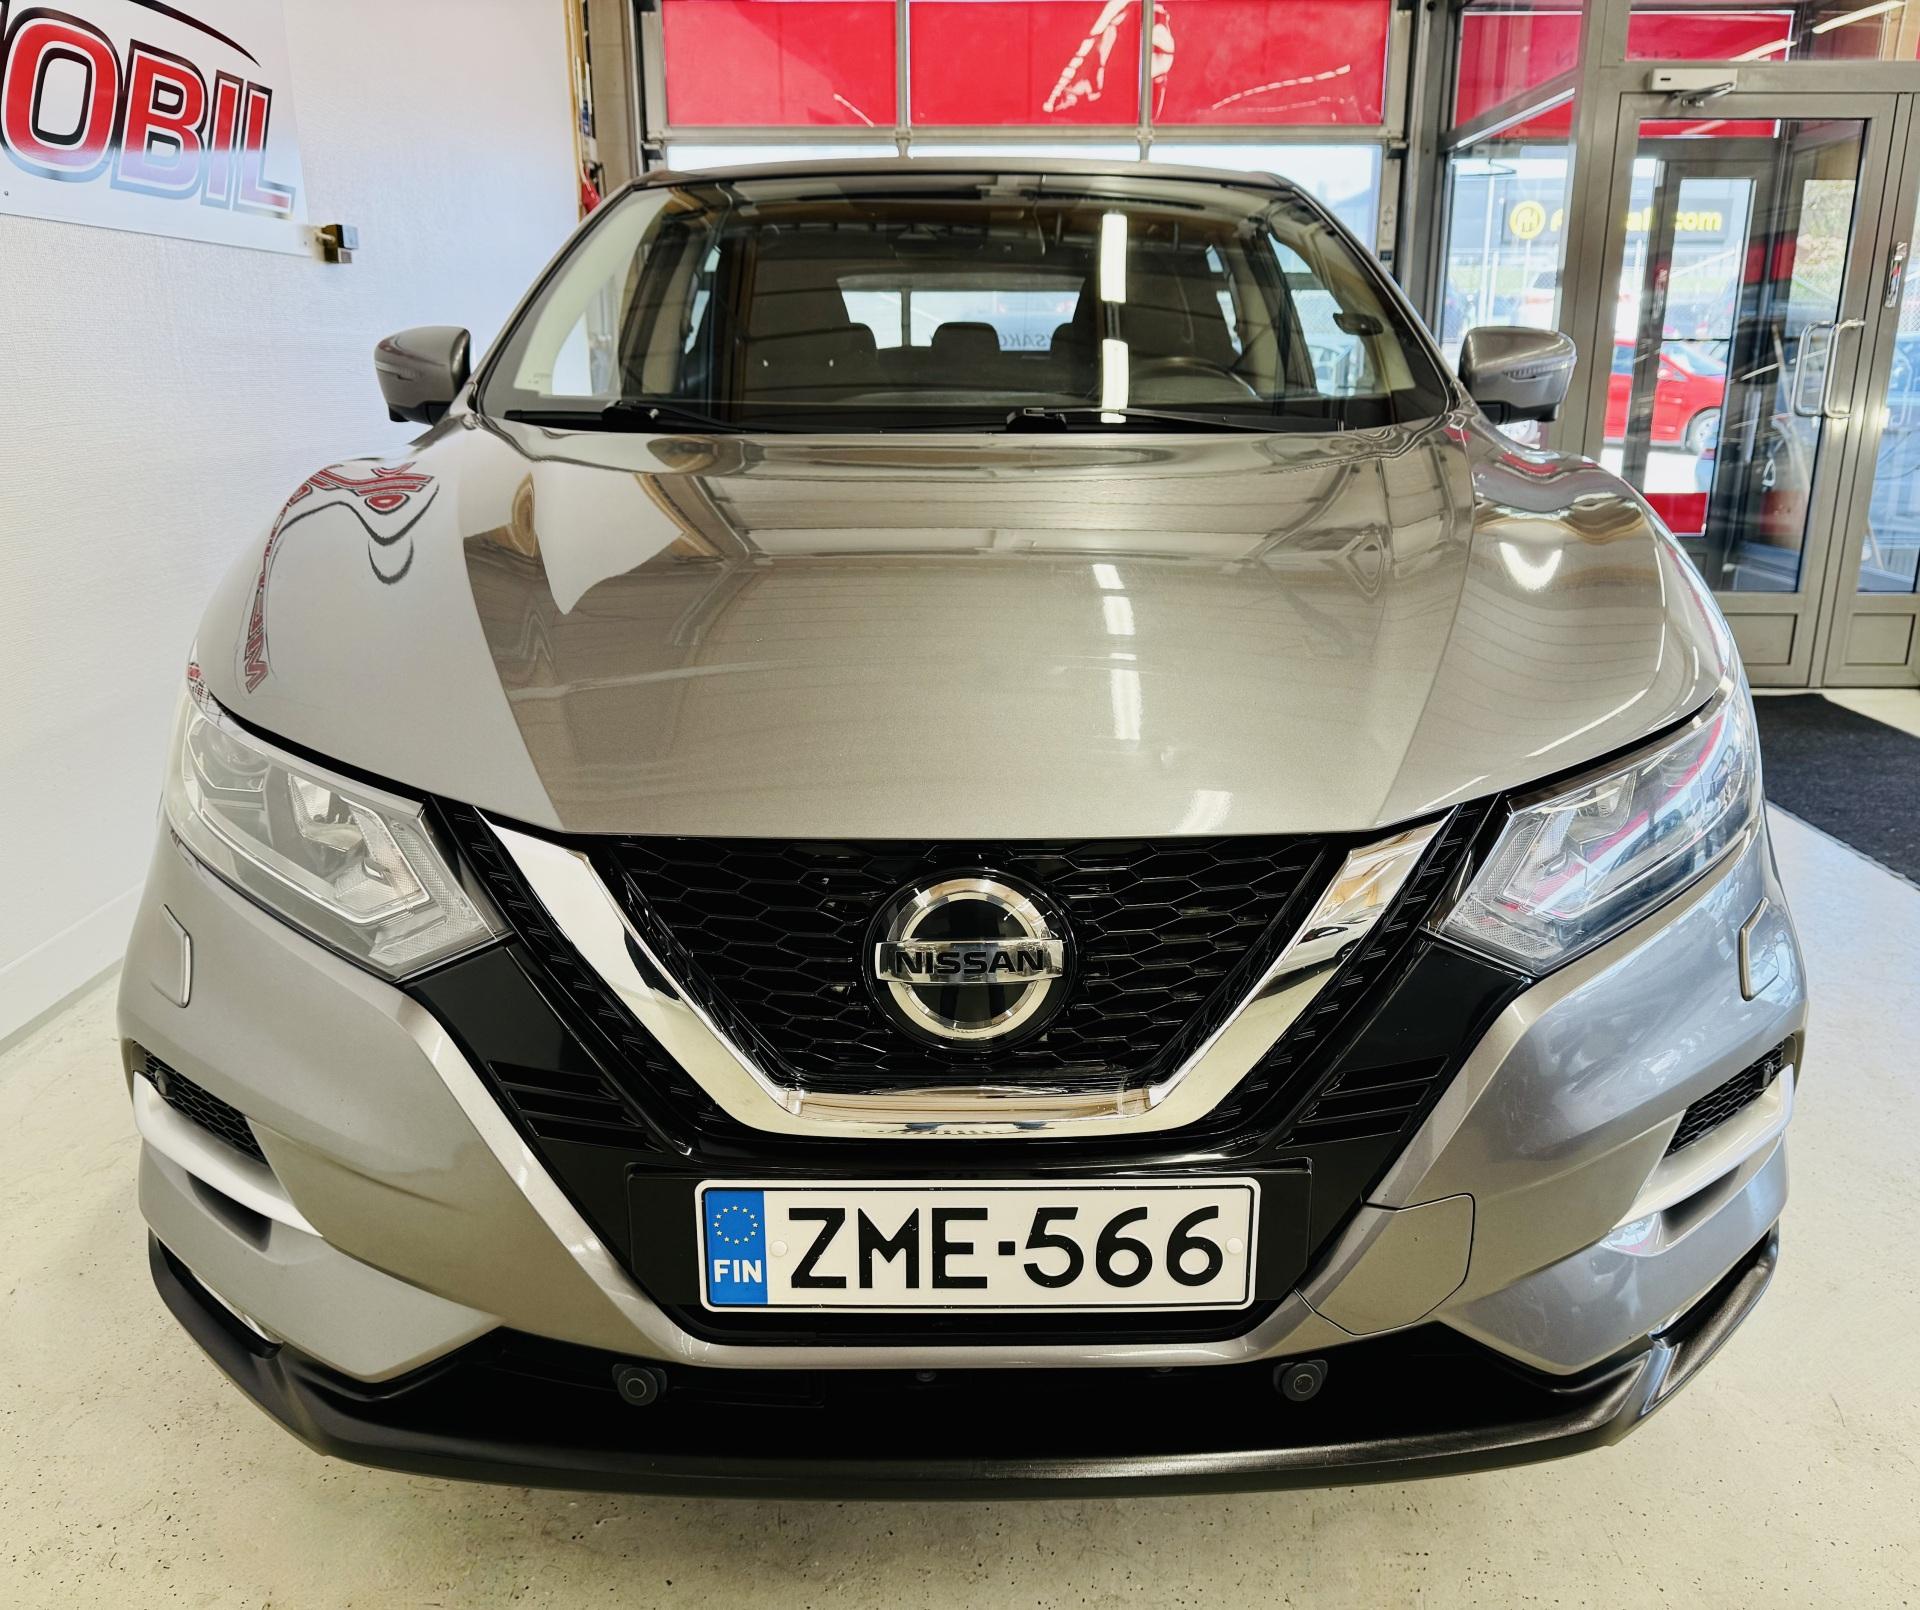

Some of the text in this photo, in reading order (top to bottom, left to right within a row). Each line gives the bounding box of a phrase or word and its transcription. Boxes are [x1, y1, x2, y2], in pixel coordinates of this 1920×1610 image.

[0, 3, 296, 218] OBIL
[896, 950, 1044, 974] NISSAN
[713, 1259, 763, 1284] FIN
